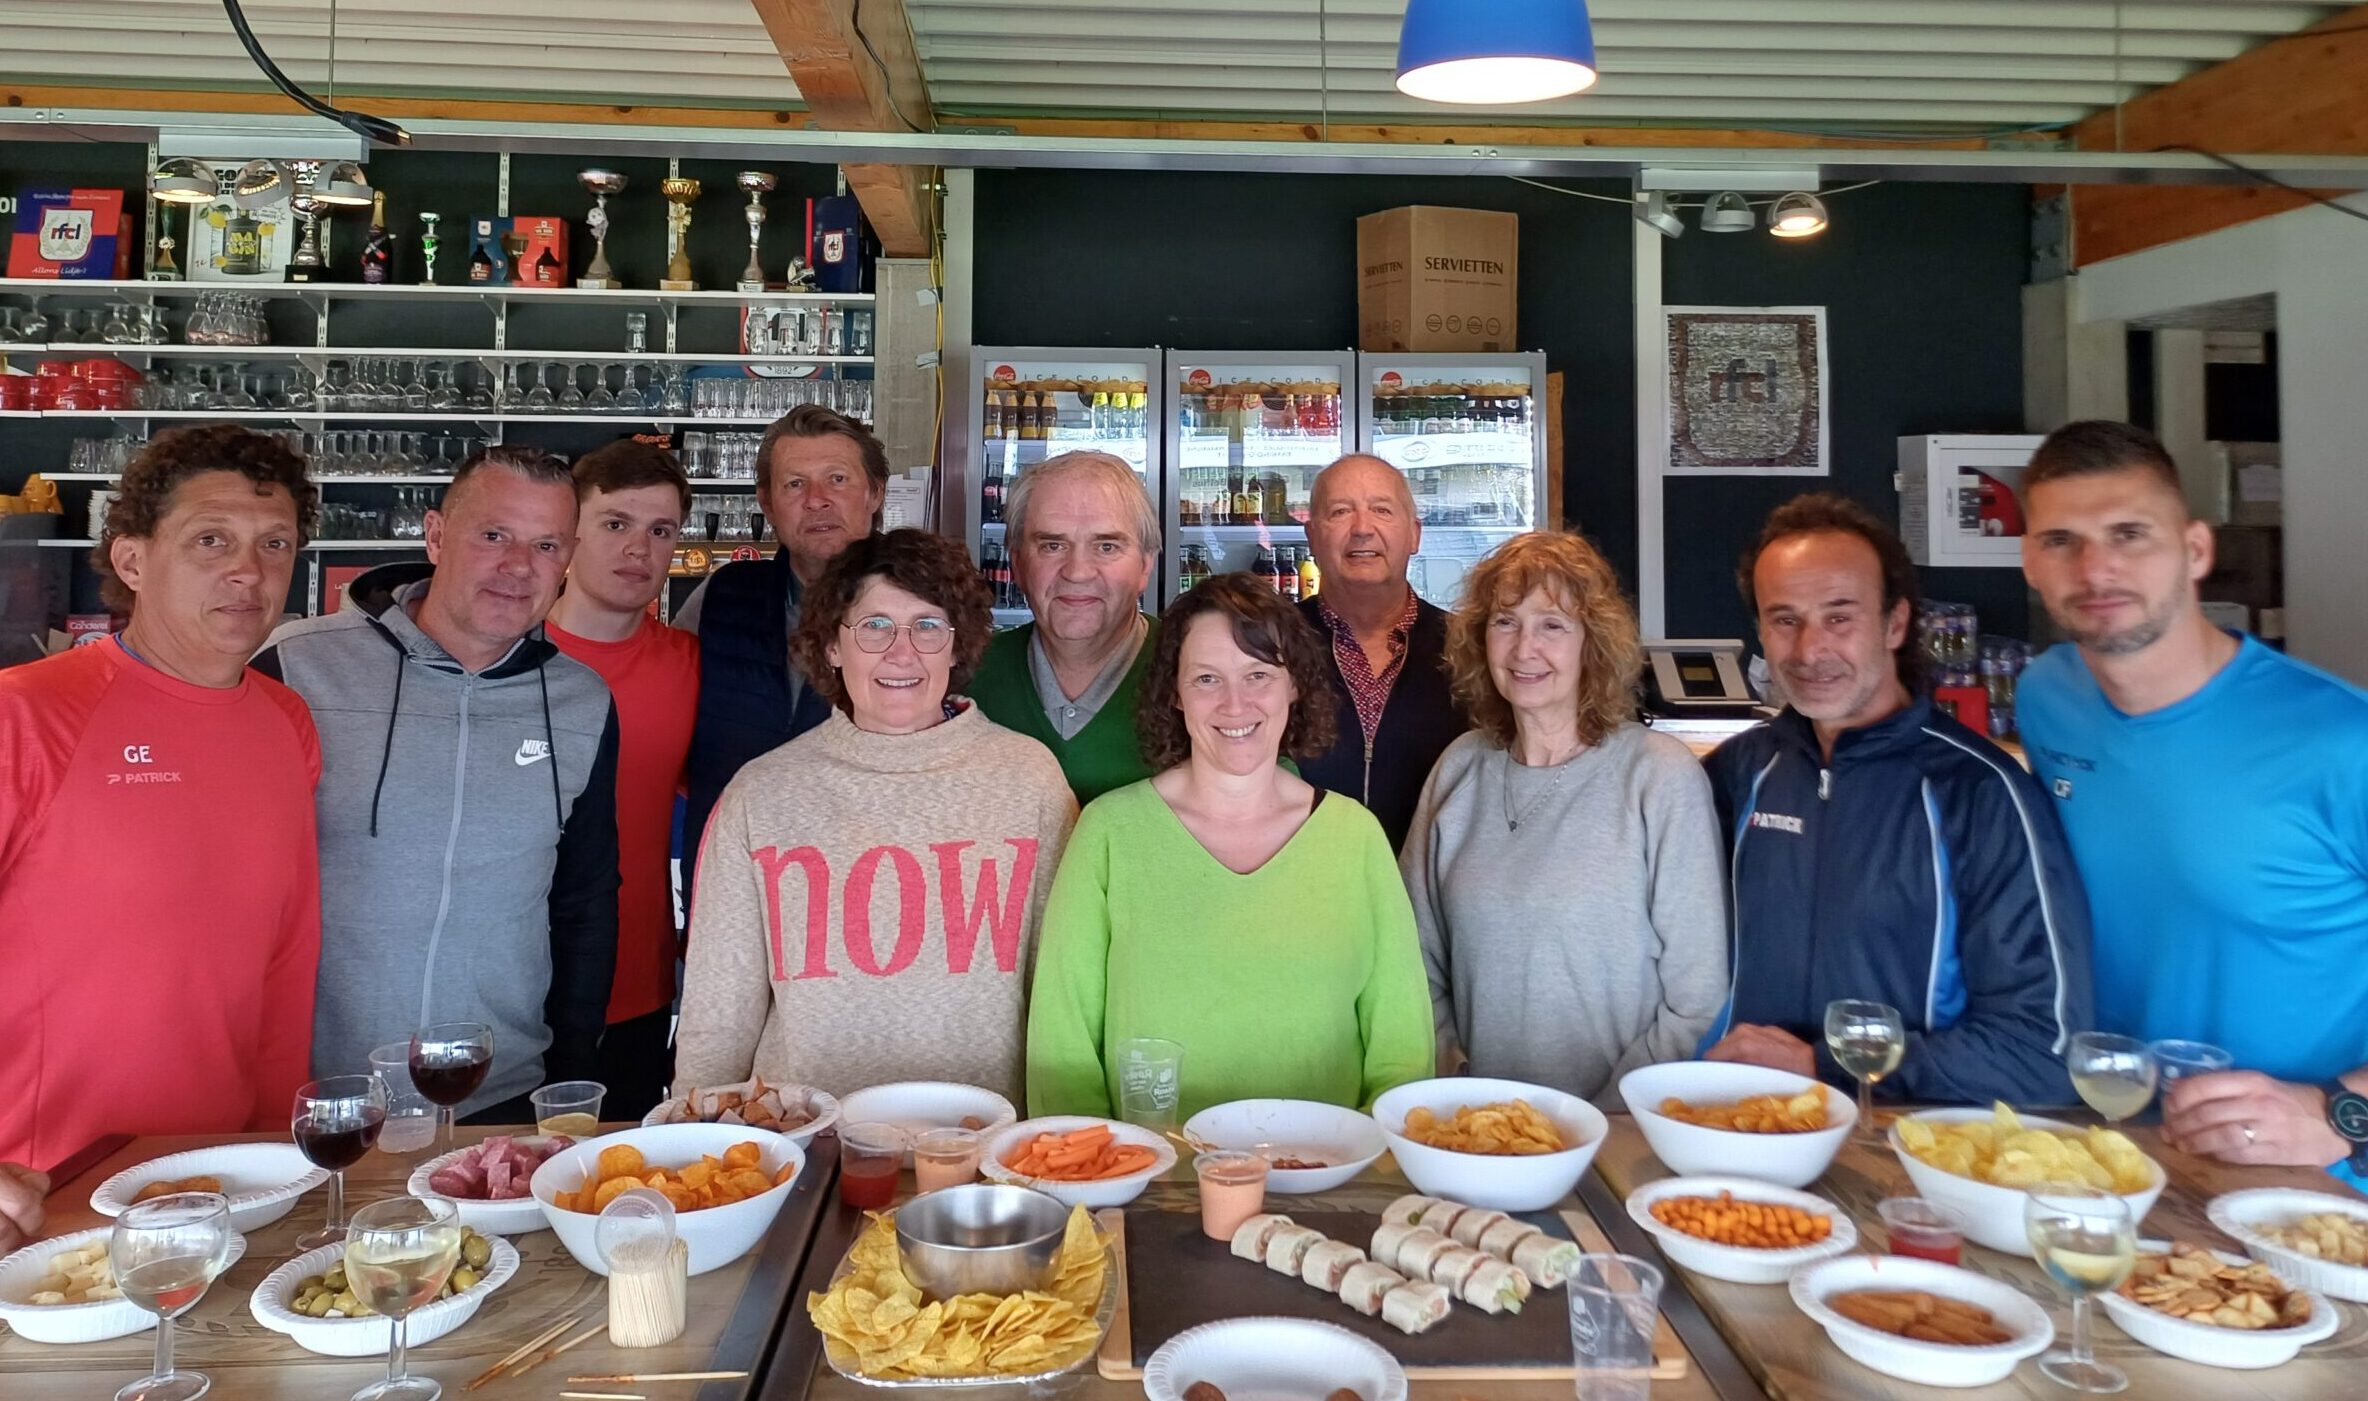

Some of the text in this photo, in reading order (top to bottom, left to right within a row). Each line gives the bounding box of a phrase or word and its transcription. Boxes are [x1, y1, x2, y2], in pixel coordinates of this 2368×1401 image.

[50, 223, 81, 240] rfcl
[1425, 256, 1503, 275] SERVIETTEN
[1708, 358, 1777, 403] rfcl
[123, 744, 153, 764] GE
[520, 739, 549, 756] NIKE
[125, 771, 182, 784] PATRICK
[751, 838, 1039, 981] now
